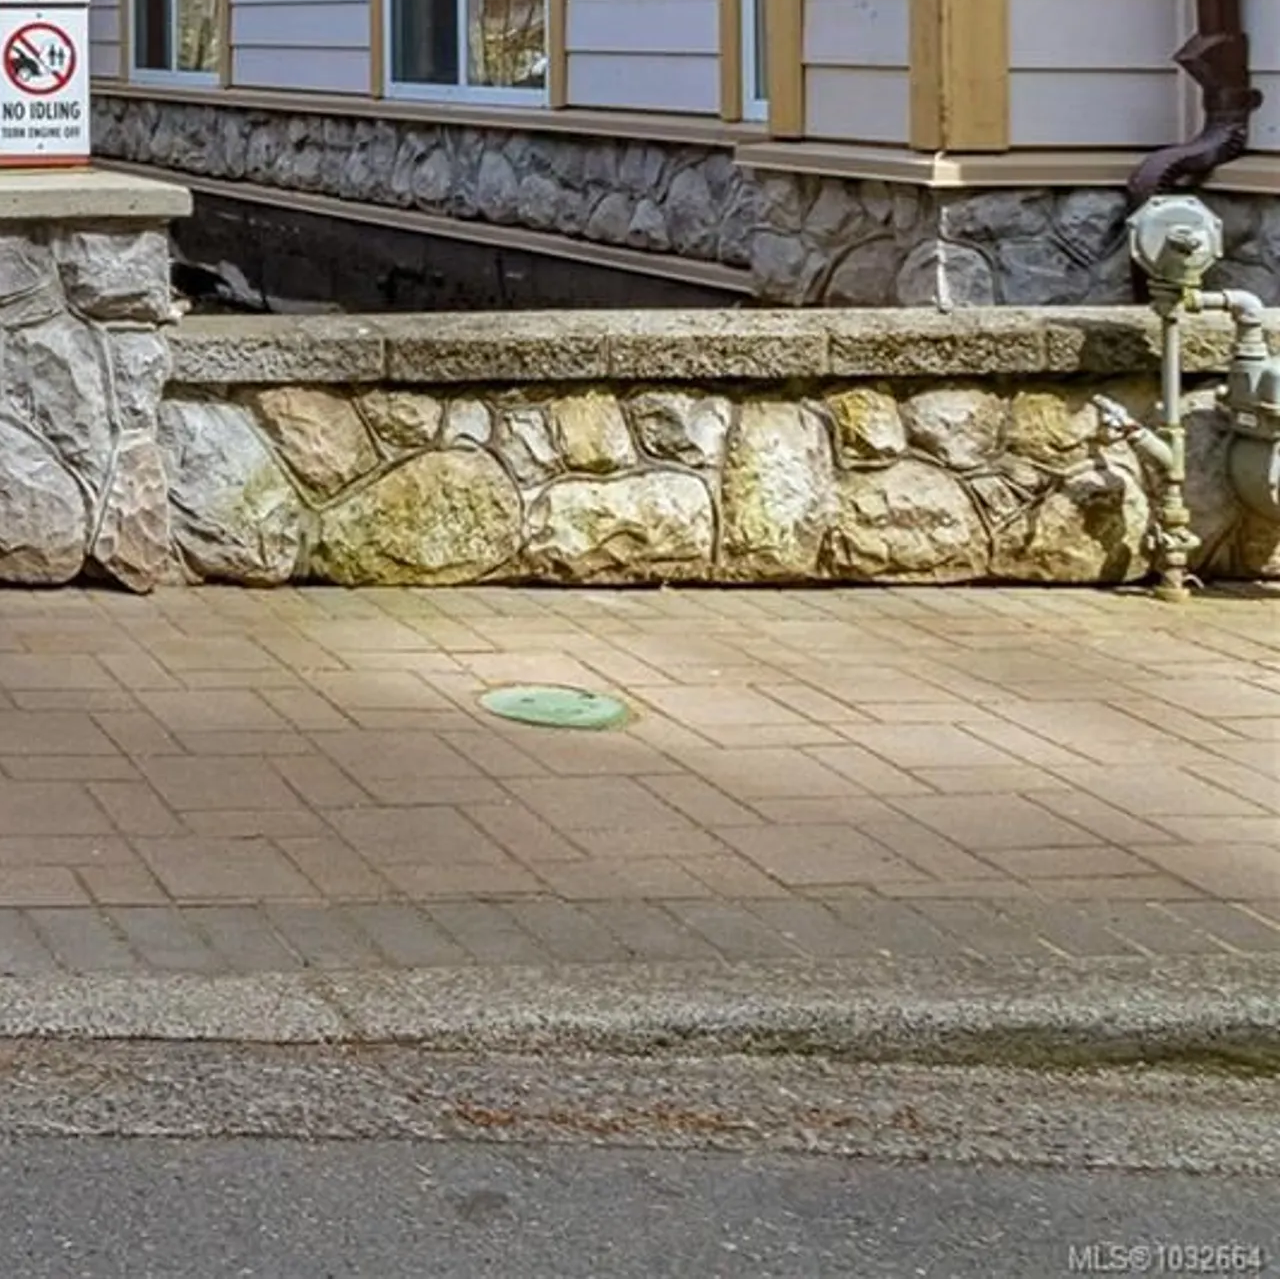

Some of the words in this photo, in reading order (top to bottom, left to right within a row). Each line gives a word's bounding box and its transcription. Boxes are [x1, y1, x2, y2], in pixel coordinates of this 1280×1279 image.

[2, 101, 26, 121] NO
[29, 101, 81, 121] IDLING
[63, 127, 81, 139] OFF
